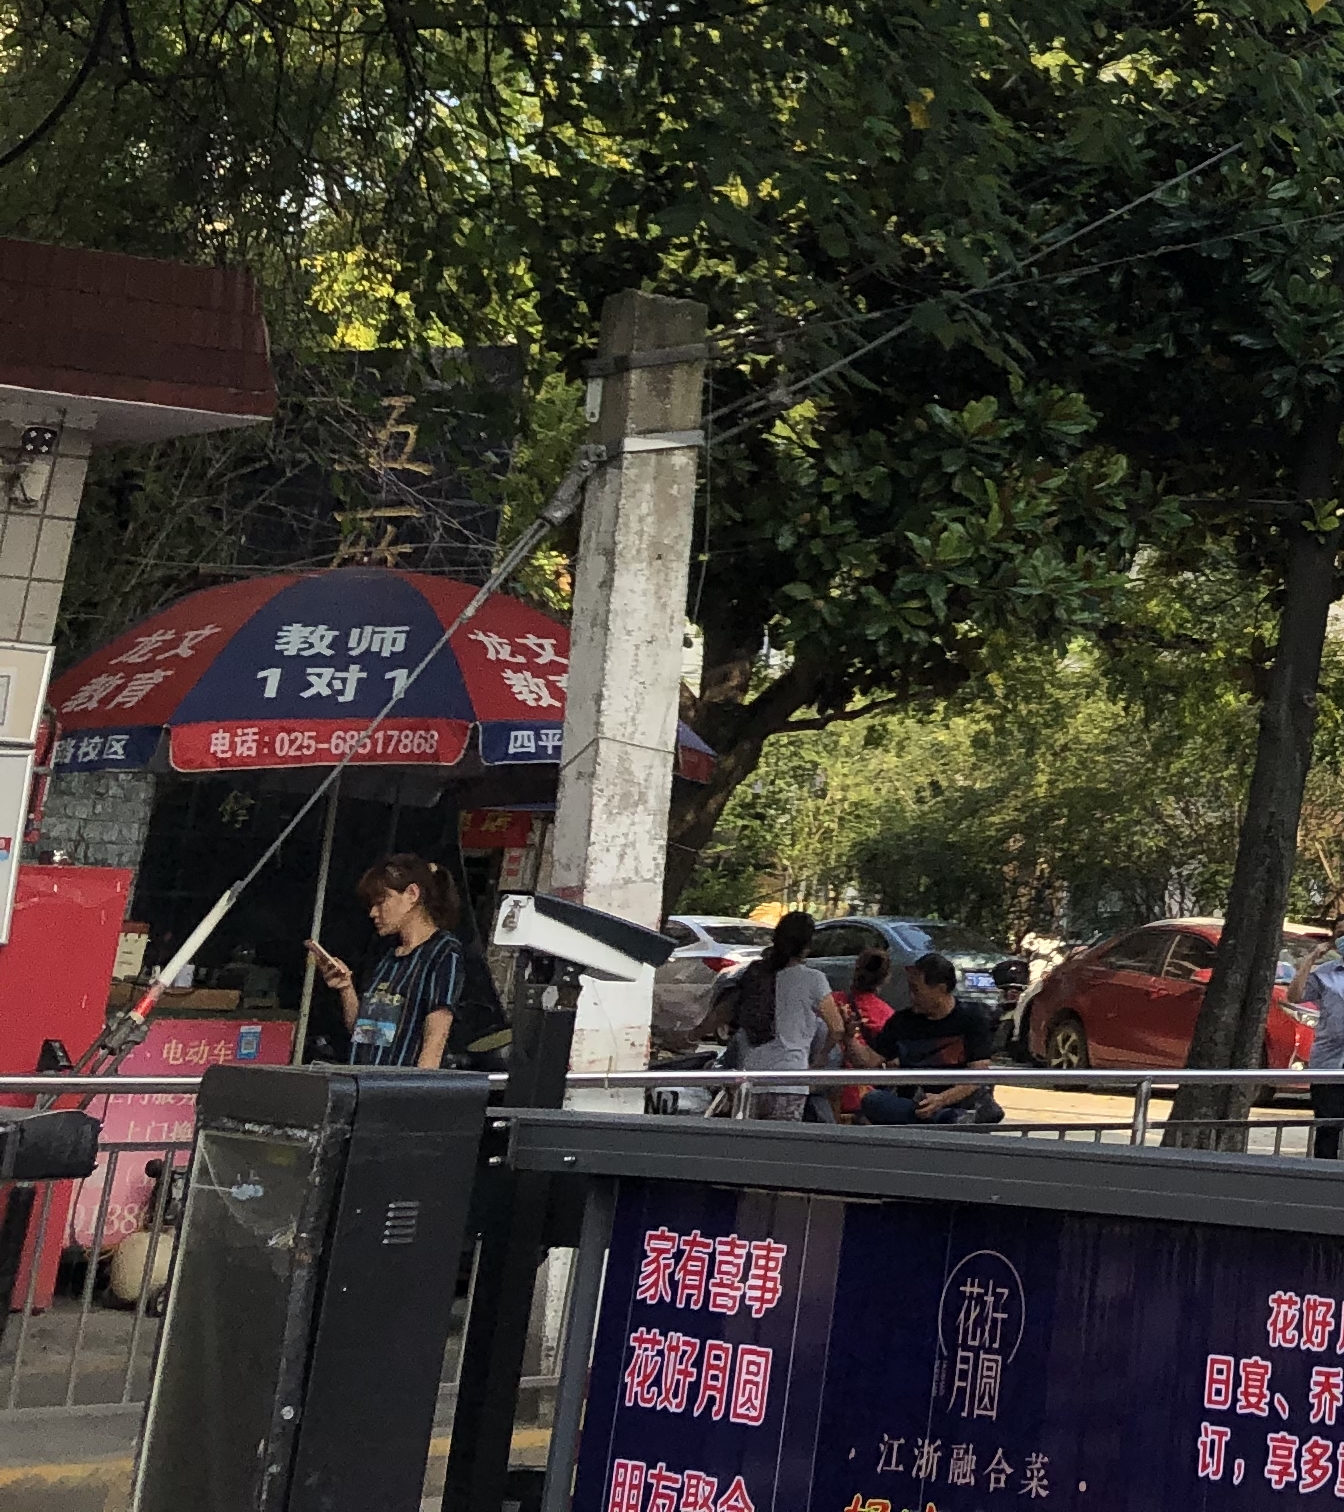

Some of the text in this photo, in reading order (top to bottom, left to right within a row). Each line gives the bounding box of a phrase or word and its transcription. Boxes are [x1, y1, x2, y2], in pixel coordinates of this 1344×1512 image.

[109, 623, 222, 664] 龙文
[274, 623, 410, 657] 教师
[468, 628, 569, 665] 龙文
[61, 667, 175, 713] 教育
[256, 664, 410, 703] 1对1
[500, 668, 568, 708] 教
[162, 1039, 234, 1065] 电动车
[636, 1227, 787, 1318] 家有喜事
[956, 1277, 1010, 1349] 花好
[625, 1327, 773, 1426] 花好月圆
[946, 1347, 1003, 1422] 月圆
[876, 1433, 1051, 1499] 江浙融合菜
